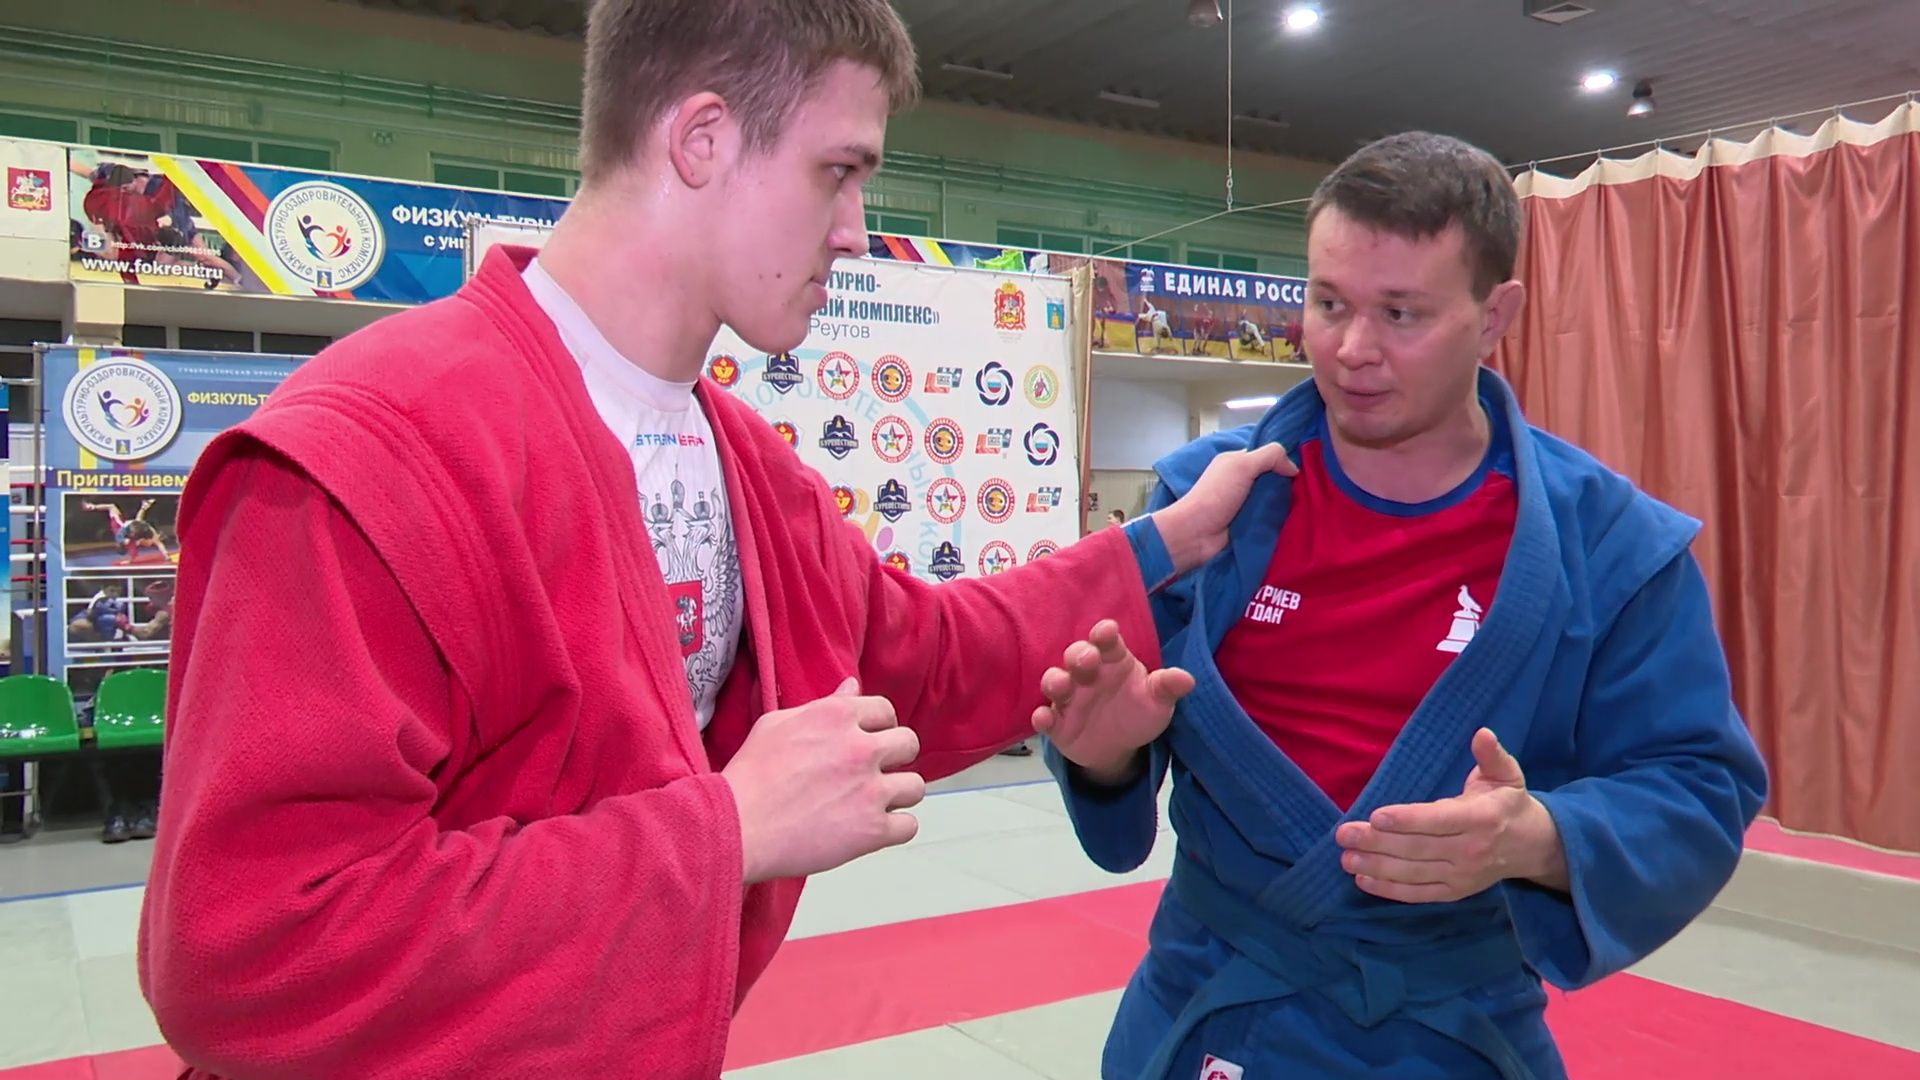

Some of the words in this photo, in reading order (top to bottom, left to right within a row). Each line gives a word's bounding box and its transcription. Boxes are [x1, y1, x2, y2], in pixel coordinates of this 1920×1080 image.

[1164, 271, 1247, 298] ЕДИНАЯ
[1254, 281, 1308, 304] РОСС
[815, 295, 844, 318] ЫЙ
[848, 299, 940, 325] КОМПЛЕКС»
[808, 317, 871, 341] Реутов
[57, 470, 188, 491] Приглашаем
